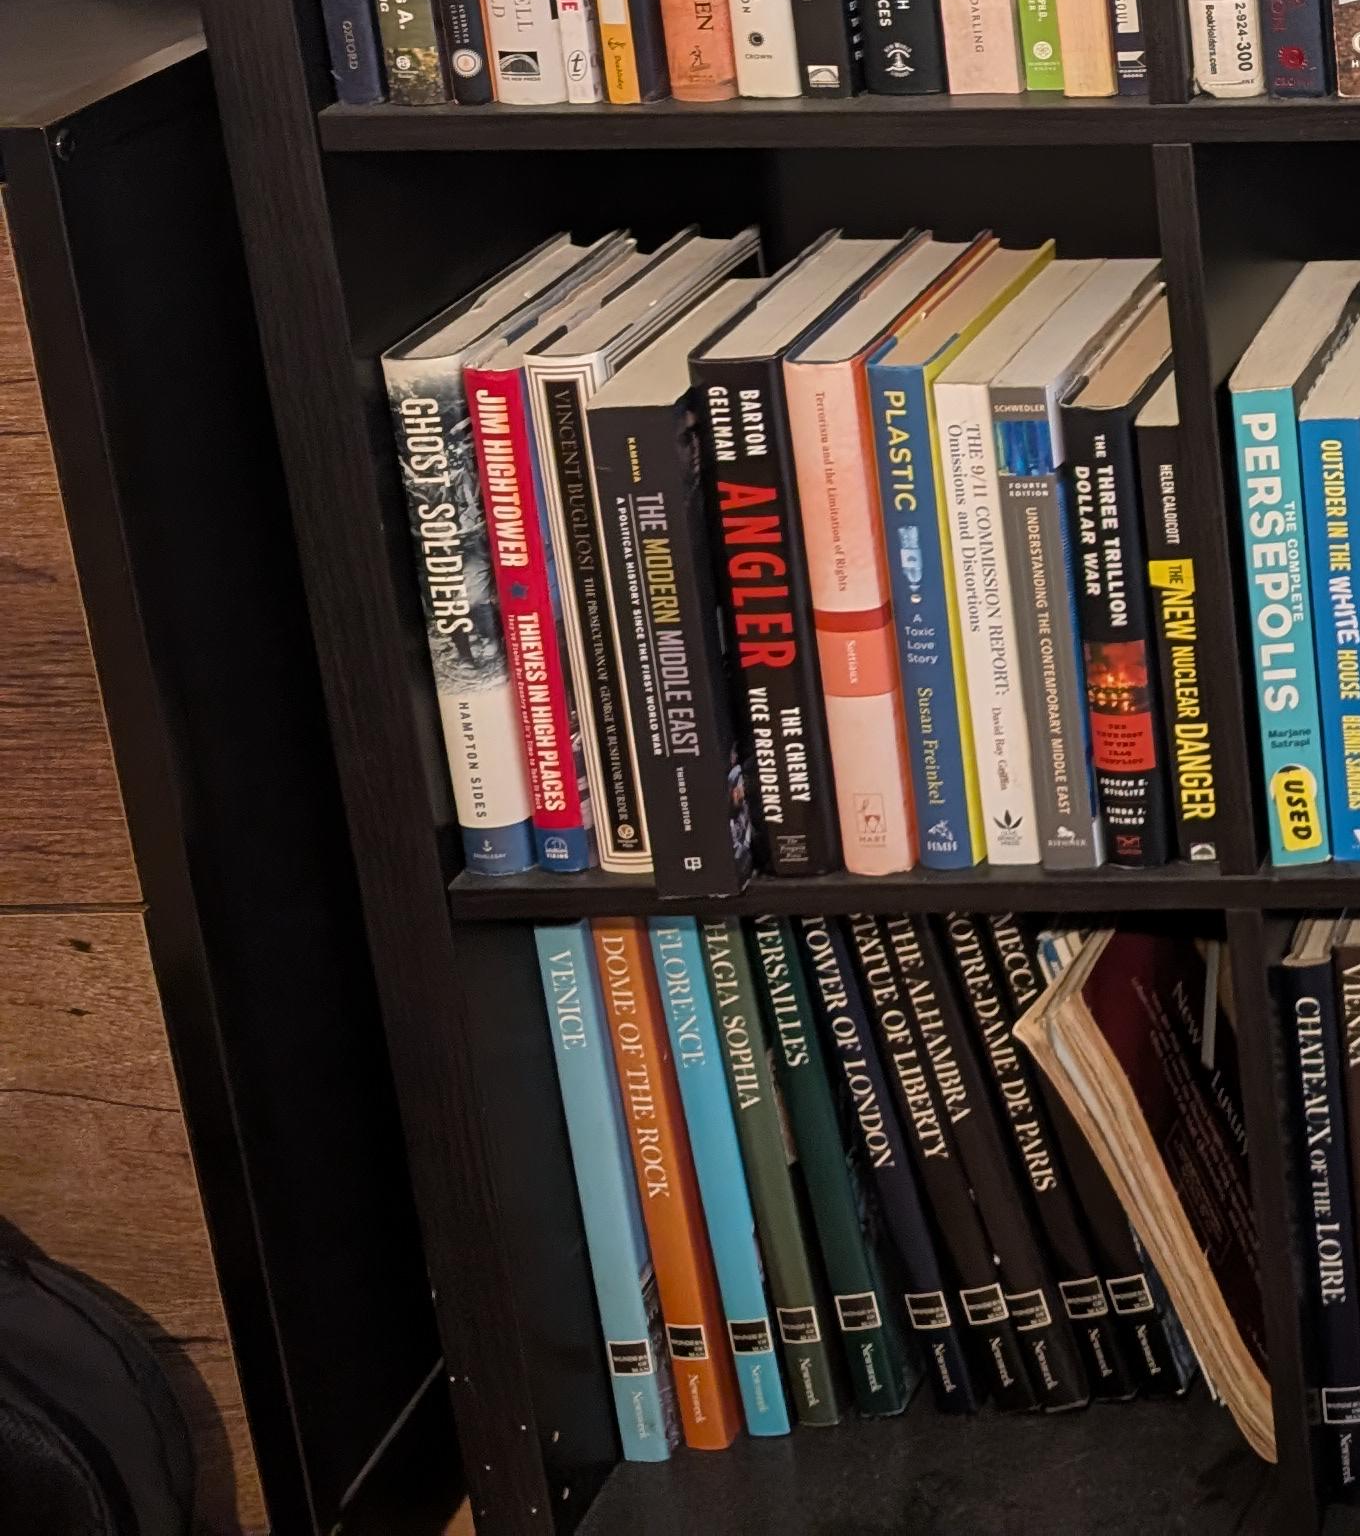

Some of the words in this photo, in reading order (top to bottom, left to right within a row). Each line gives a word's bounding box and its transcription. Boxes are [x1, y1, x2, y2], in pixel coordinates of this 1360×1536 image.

[402, 398, 451, 503] GHOST
[994, 404, 1045, 413] SCHWEDLER
[419, 504, 473, 634] SOLDIERS
[718, 482, 796, 669] ANGLER
[1241, 413, 1298, 712] PERSEPOLIS
[1283, 779, 1311, 841] USED
[548, 950, 585, 1050] VENICE
[657, 927, 706, 1070] FLORENCE
